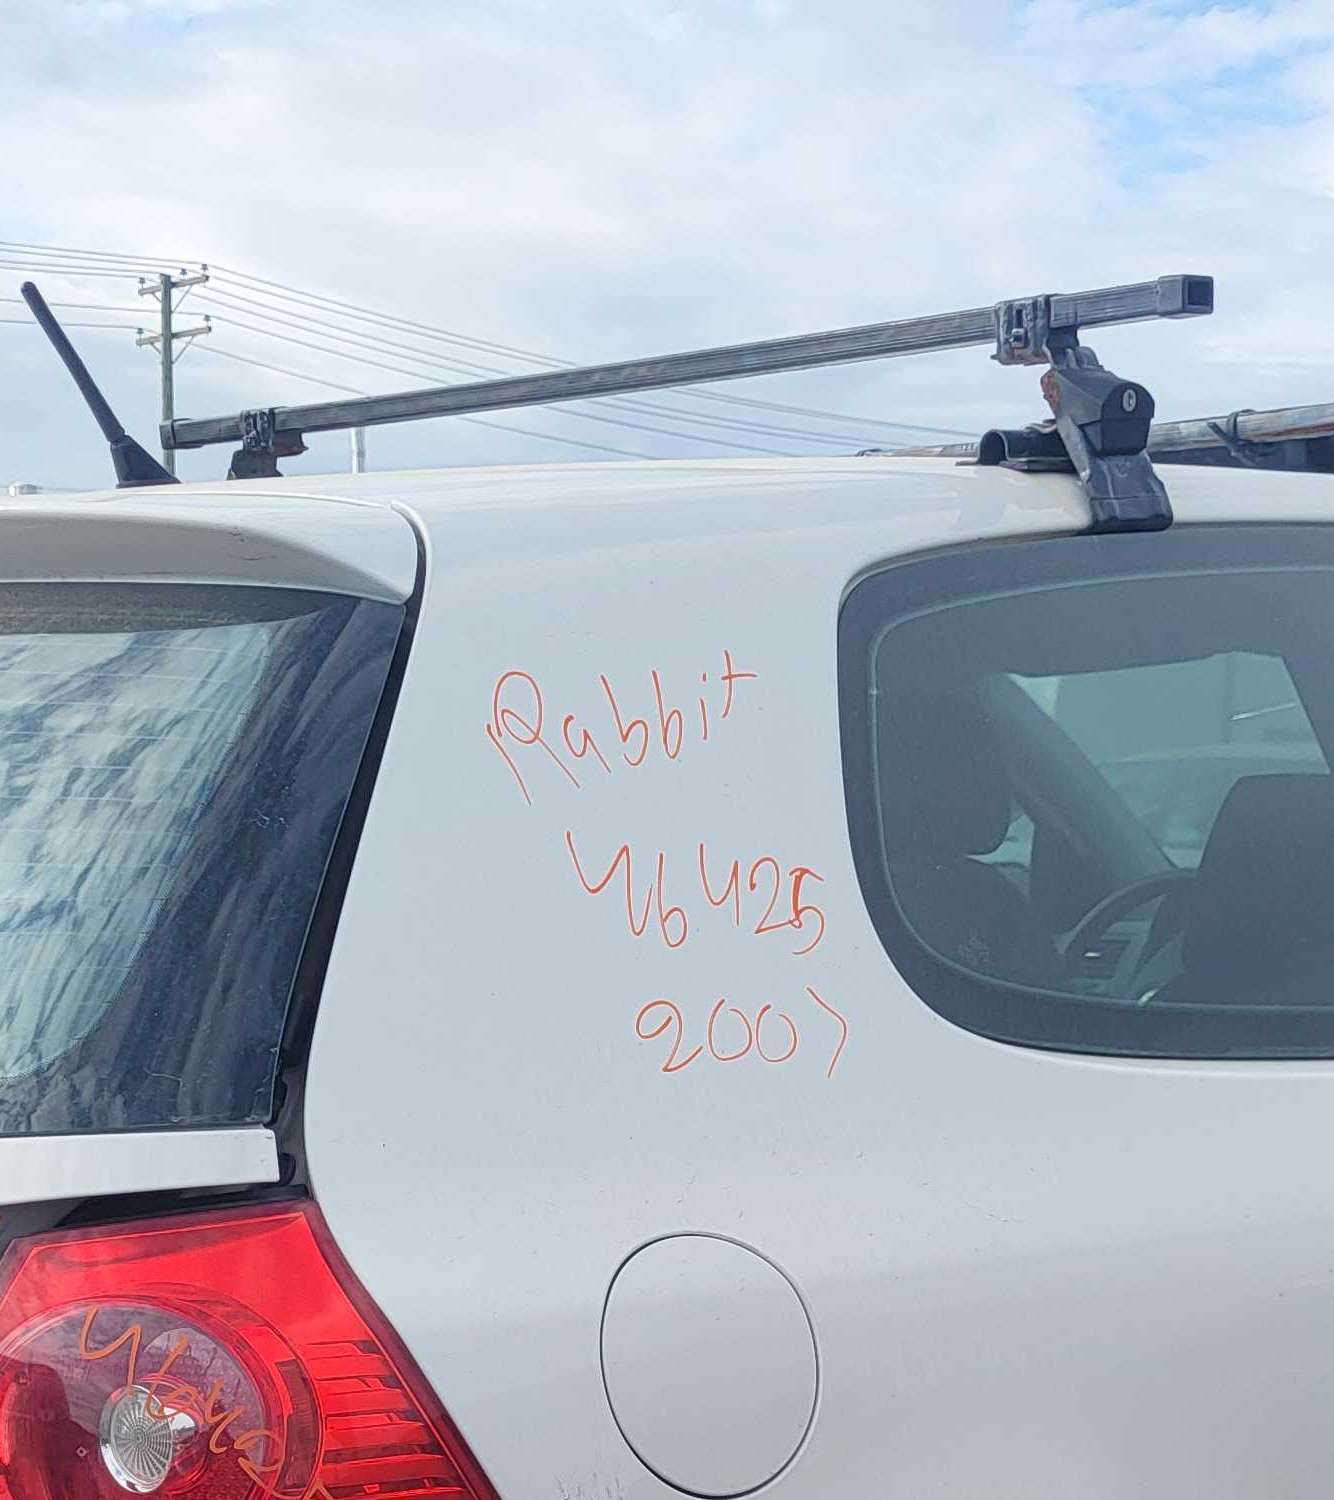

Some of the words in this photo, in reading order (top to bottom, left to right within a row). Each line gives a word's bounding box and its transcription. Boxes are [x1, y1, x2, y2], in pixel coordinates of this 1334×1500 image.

[485, 650, 758, 806] Rabbit
[566, 830, 825, 956] 46425
[635, 986, 848, 1079] 2007
